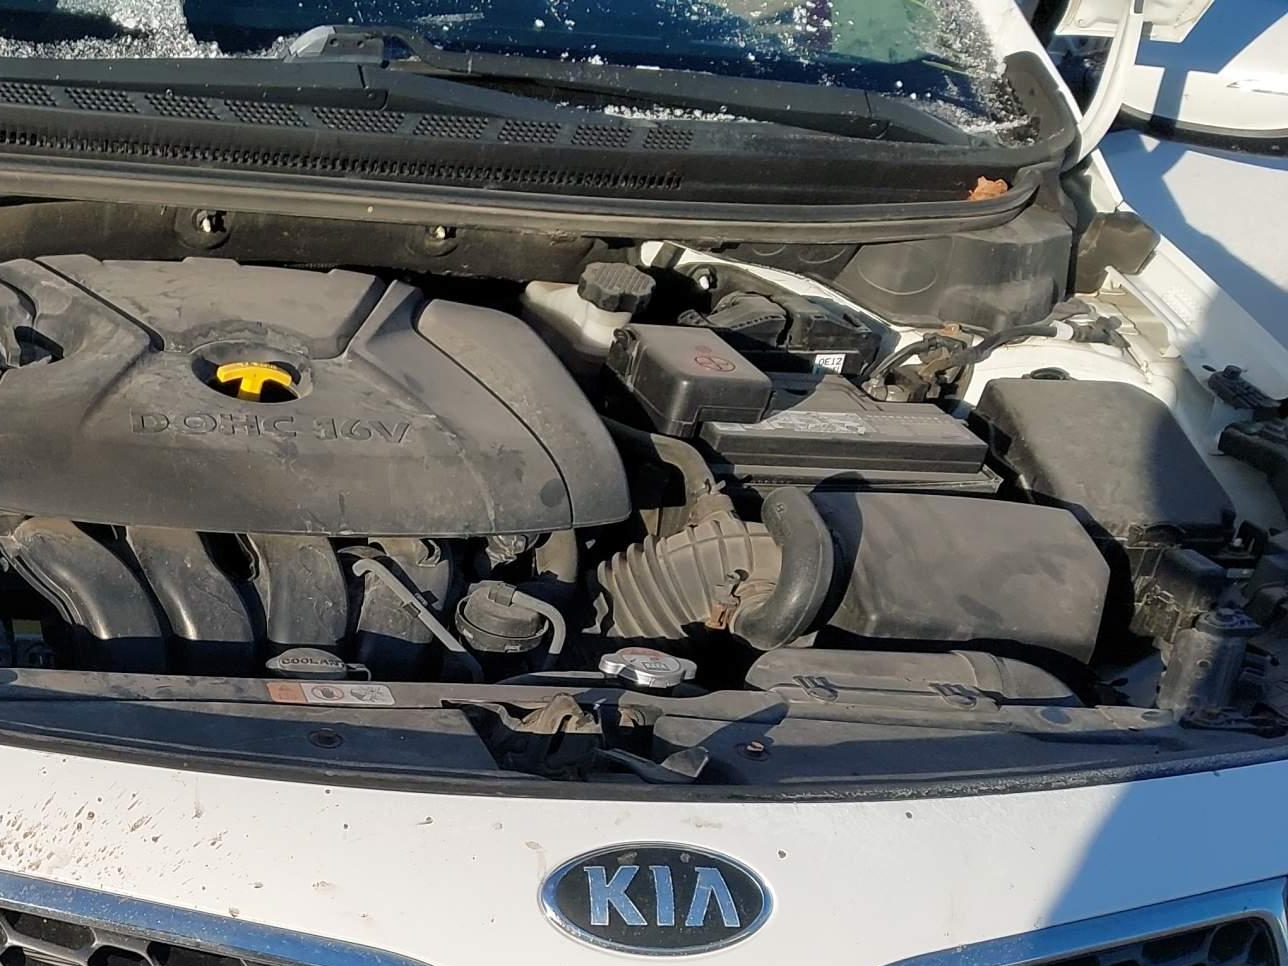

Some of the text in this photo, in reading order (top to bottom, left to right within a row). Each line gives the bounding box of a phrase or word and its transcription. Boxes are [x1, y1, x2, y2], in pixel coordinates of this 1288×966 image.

[130, 410, 411, 444] DOHC 16V
[583, 865, 740, 927] KIA
